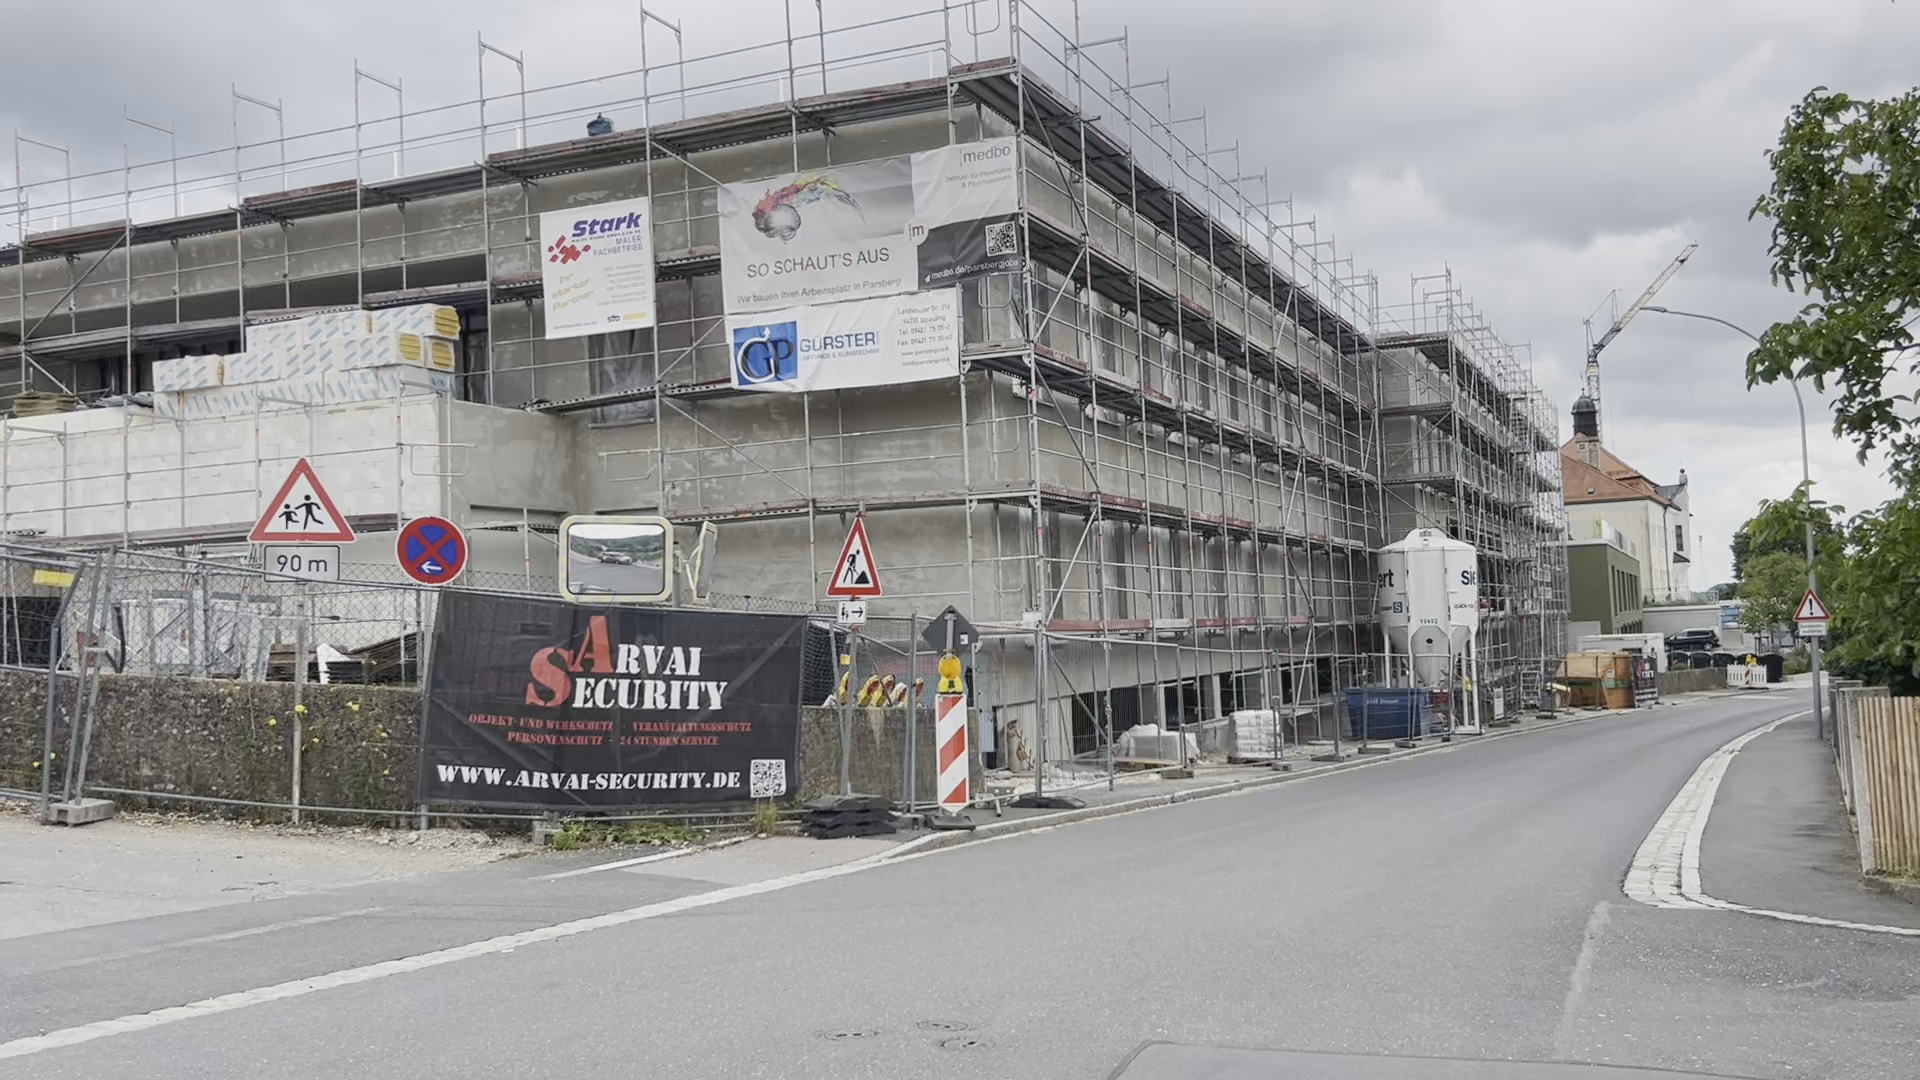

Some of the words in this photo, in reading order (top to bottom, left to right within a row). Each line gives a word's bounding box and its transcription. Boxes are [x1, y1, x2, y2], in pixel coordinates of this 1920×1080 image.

[963, 146, 1011, 163] medbo
[571, 212, 643, 238] Stark
[747, 263, 769, 278] SO
[773, 252, 853, 275] SCHAUT'S
[856, 247, 890, 265] AUS
[559, 273, 574, 285] Ihr
[552, 290, 595, 312] Partner
[736, 294, 752, 304] Wir
[752, 292, 779, 303] bauen
[801, 284, 851, 297] Arbeitsplatz
[853, 282, 861, 291] in
[862, 278, 902, 290] Parsberg
[800, 331, 876, 352] GÜRSTER
[277, 554, 302, 573] 90
[308, 559, 328, 573] m
[571, 615, 703, 676] ARVAI
[525, 646, 728, 710] SECURITY
[468, 713, 518, 727] OBJEKT-
[519, 717, 543, 729] UND
[546, 720, 614, 731] WERKSCHUTZ
[632, 721, 752, 732] VERANSTALTUNGSSCHUTZ
[507, 731, 603, 746] PERSONENSCHUTZ
[620, 736, 632, 745] 24
[633, 736, 679, 746] STUNDEN
[681, 736, 720, 746] SERVICE
[436, 764, 741, 790] WWW.ARVAI-SECURITY.DE
